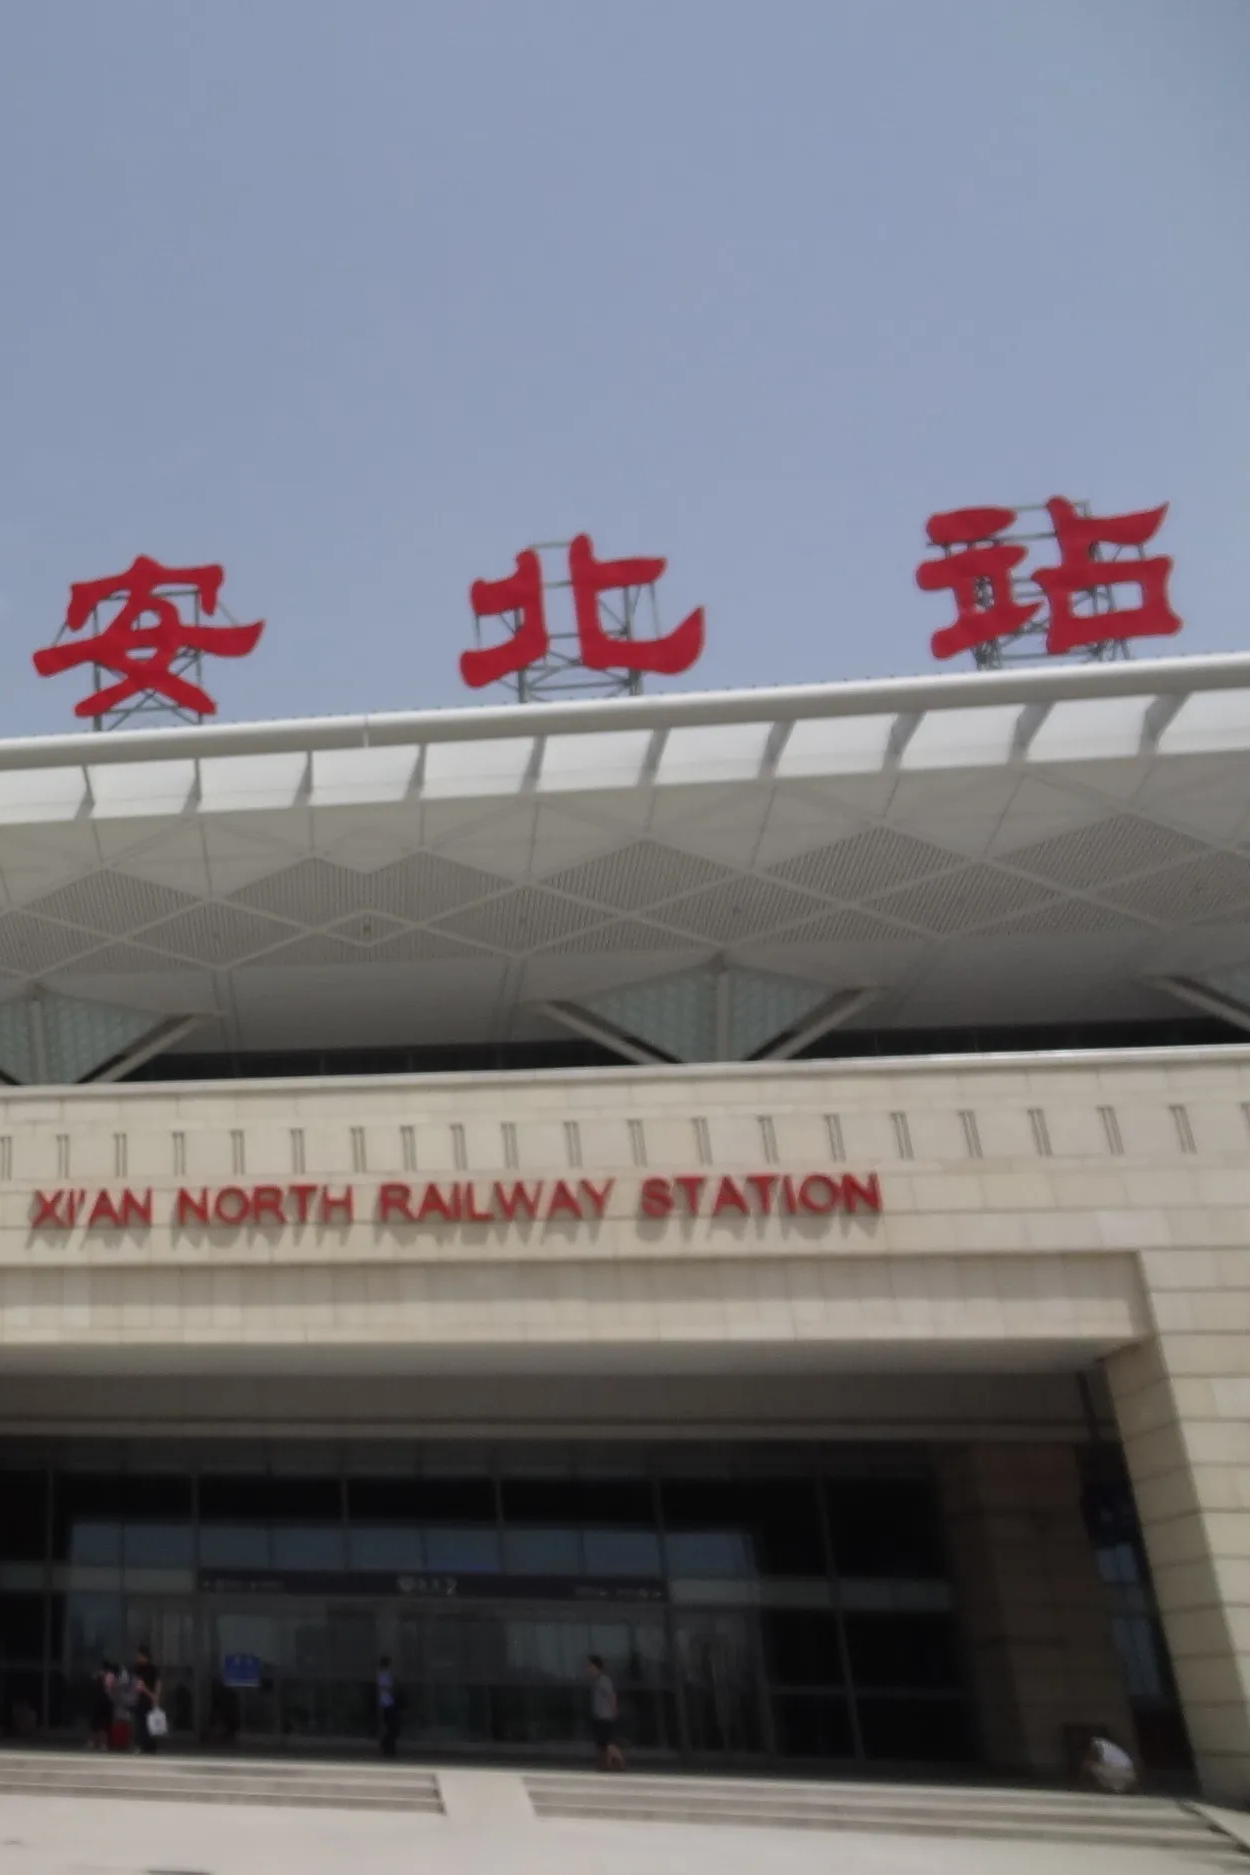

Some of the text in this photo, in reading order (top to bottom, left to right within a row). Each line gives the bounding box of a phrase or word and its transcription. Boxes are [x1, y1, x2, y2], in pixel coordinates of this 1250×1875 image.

[32, 1173, 883, 1229] XI'AN NORTH RAILWAY STATION
